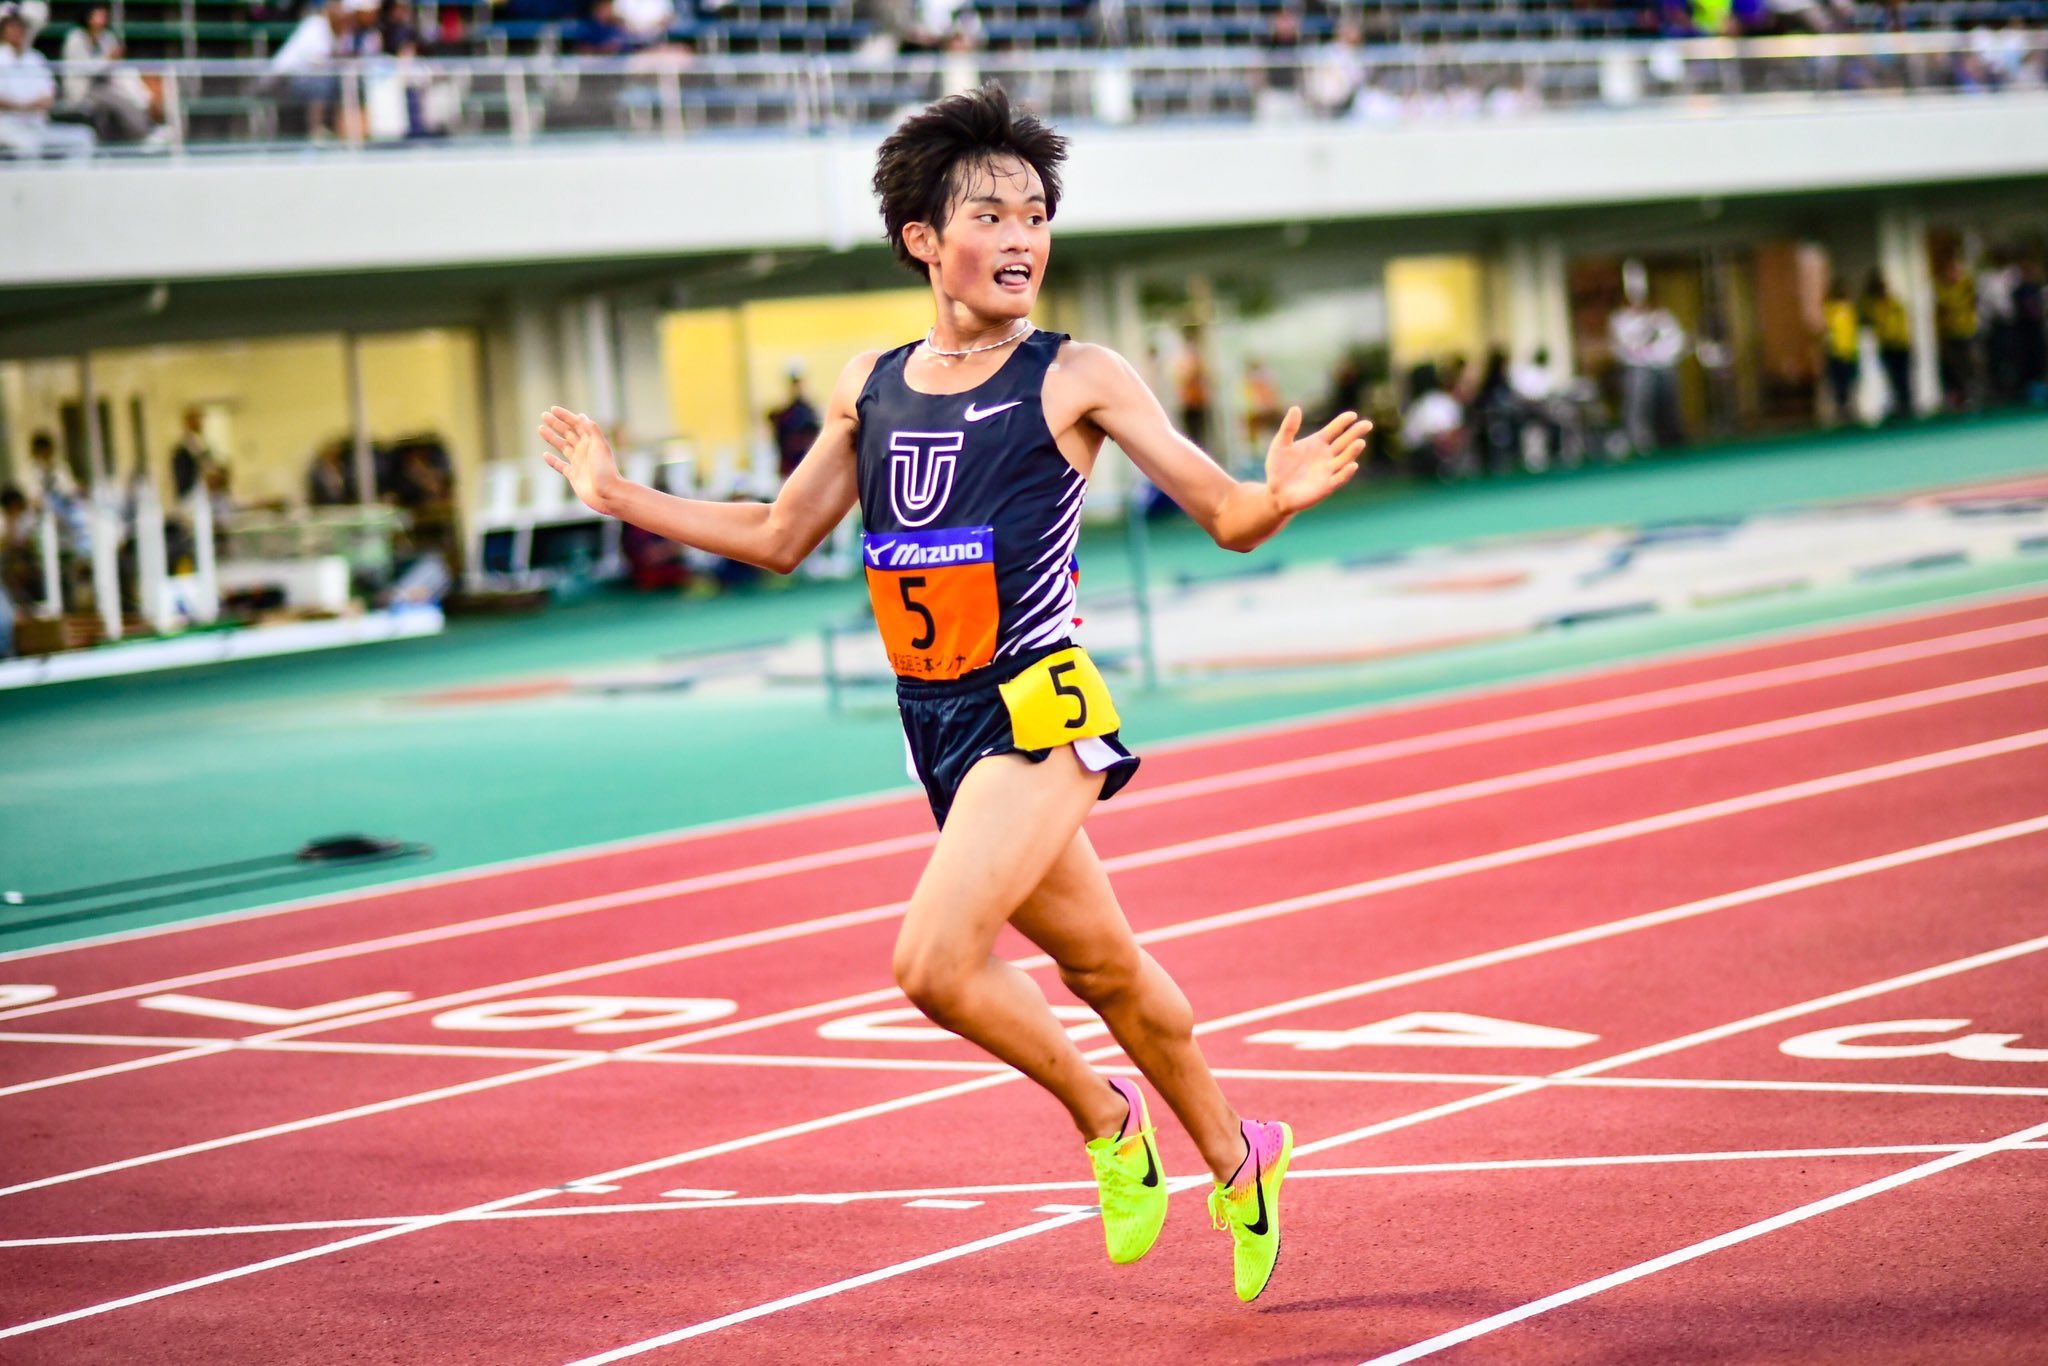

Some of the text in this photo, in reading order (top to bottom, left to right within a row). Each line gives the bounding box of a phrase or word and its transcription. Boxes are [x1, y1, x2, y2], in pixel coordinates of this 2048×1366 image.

[899, 576, 936, 650] 5
[1048, 660, 1088, 729] 5
[1243, 1011, 1600, 1051] 4
